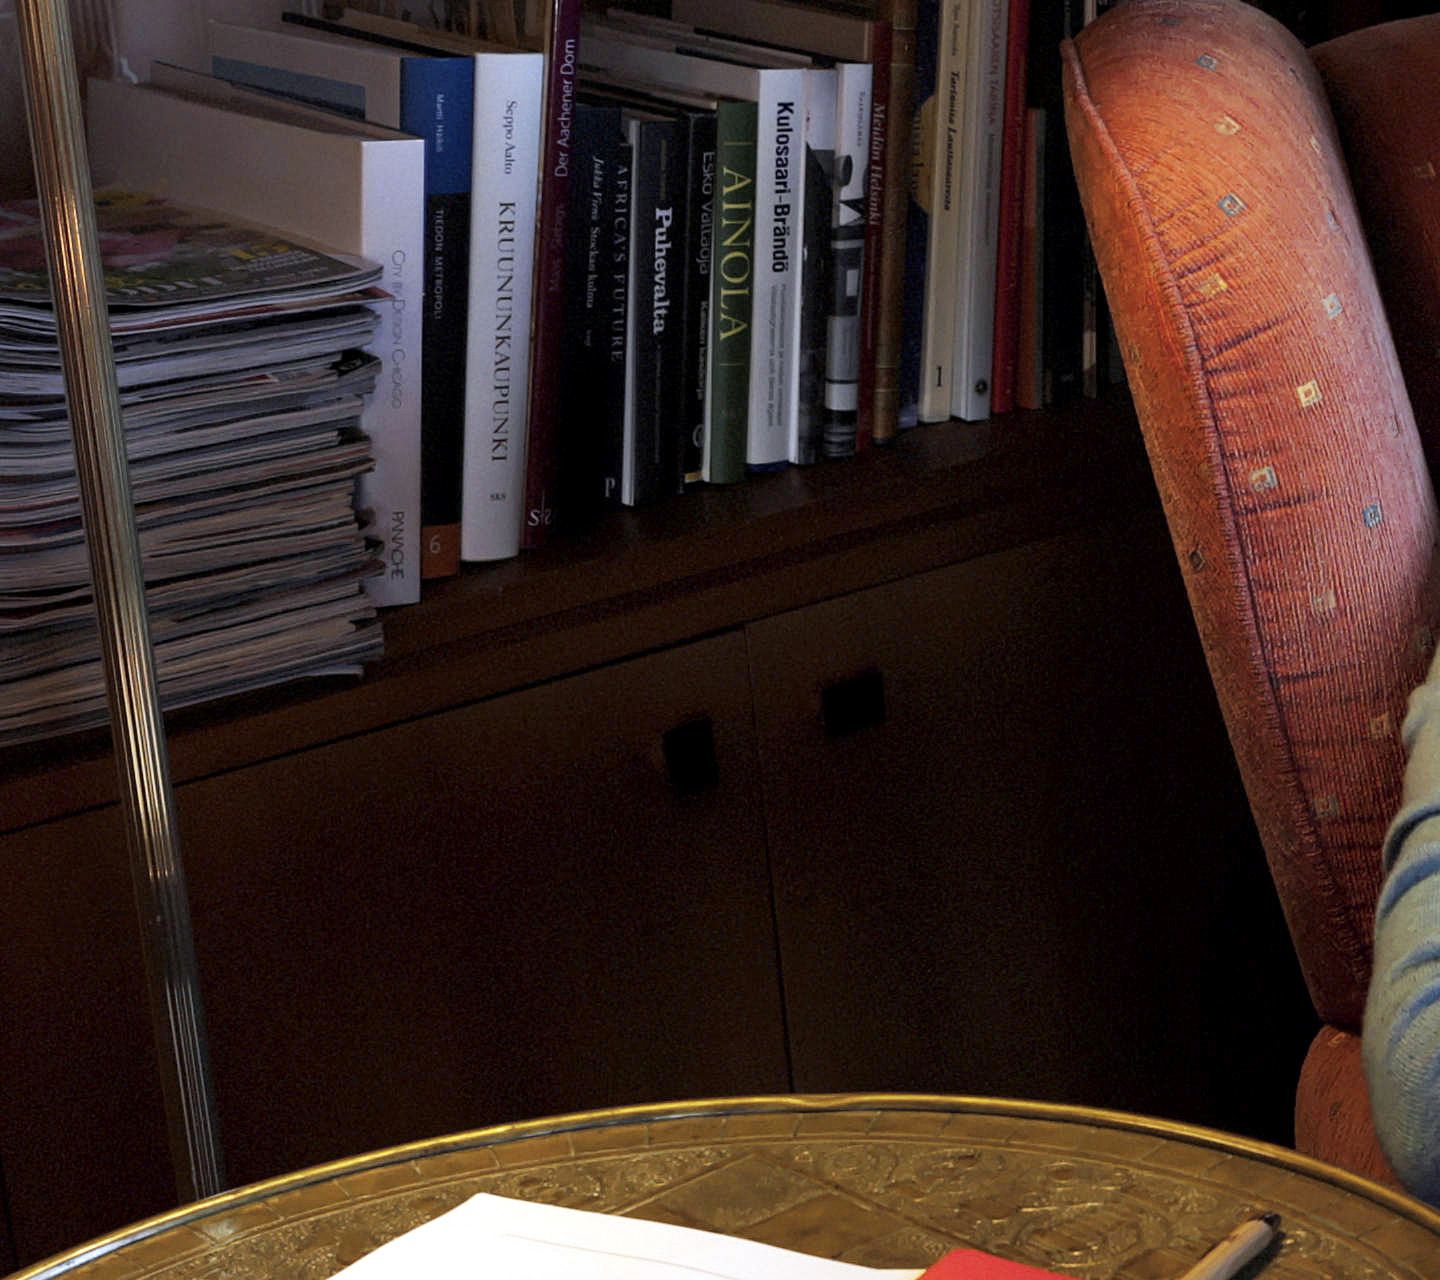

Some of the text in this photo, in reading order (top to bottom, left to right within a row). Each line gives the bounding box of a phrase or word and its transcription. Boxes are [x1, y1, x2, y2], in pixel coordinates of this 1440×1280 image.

[503, 99, 518, 175] Seppo Aalto
[552, 37, 577, 176] Der Aachener Dom
[866, 102, 886, 226] Meidän Helsinki
[770, 100, 796, 273] Kulosaari-Brändö
[431, 209, 445, 320] TIEDON METROPOLI
[652, 207, 674, 336] Puhevalta
[720, 166, 753, 342] AINOLA
[492, 202, 517, 464] KRUUNUNKAUPUNKI
[611, 274, 627, 361] FUTURE
[391, 511, 406, 580] PANACHE
[429, 534, 442, 556] 6
